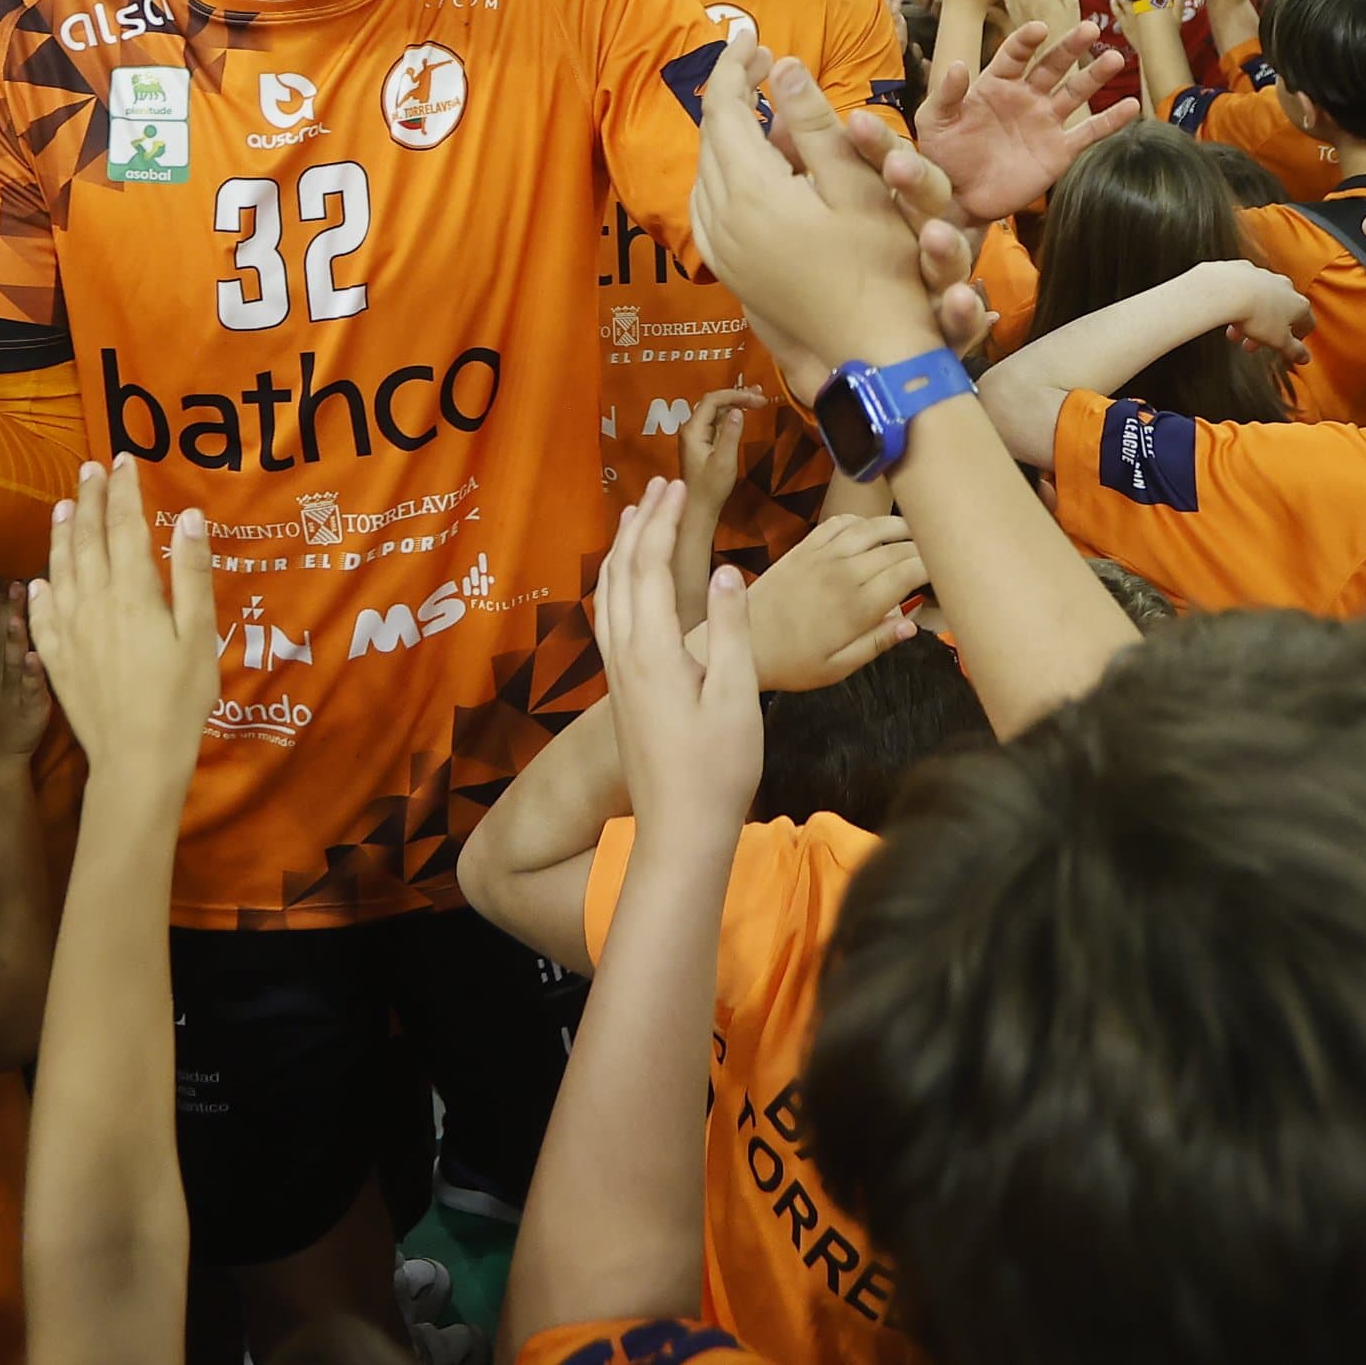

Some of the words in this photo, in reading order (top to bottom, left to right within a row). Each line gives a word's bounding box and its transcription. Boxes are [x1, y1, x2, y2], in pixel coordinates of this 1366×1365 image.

[124, 105, 173, 117] plenitude
[124, 168, 173, 183] asobal
[213, 160, 373, 332] 32
[640, 316, 748, 338] TORRELAVEGA
[100, 347, 502, 474] bathco
[1121, 417, 1139, 466] LEAGUE
[342, 475, 480, 534] TORRELAVEGA
[210, 554, 288, 574] ENTIR
[299, 552, 333, 571] EL
[469, 586, 550, 613] FACILITIES
[347, 579, 468, 662] MS
